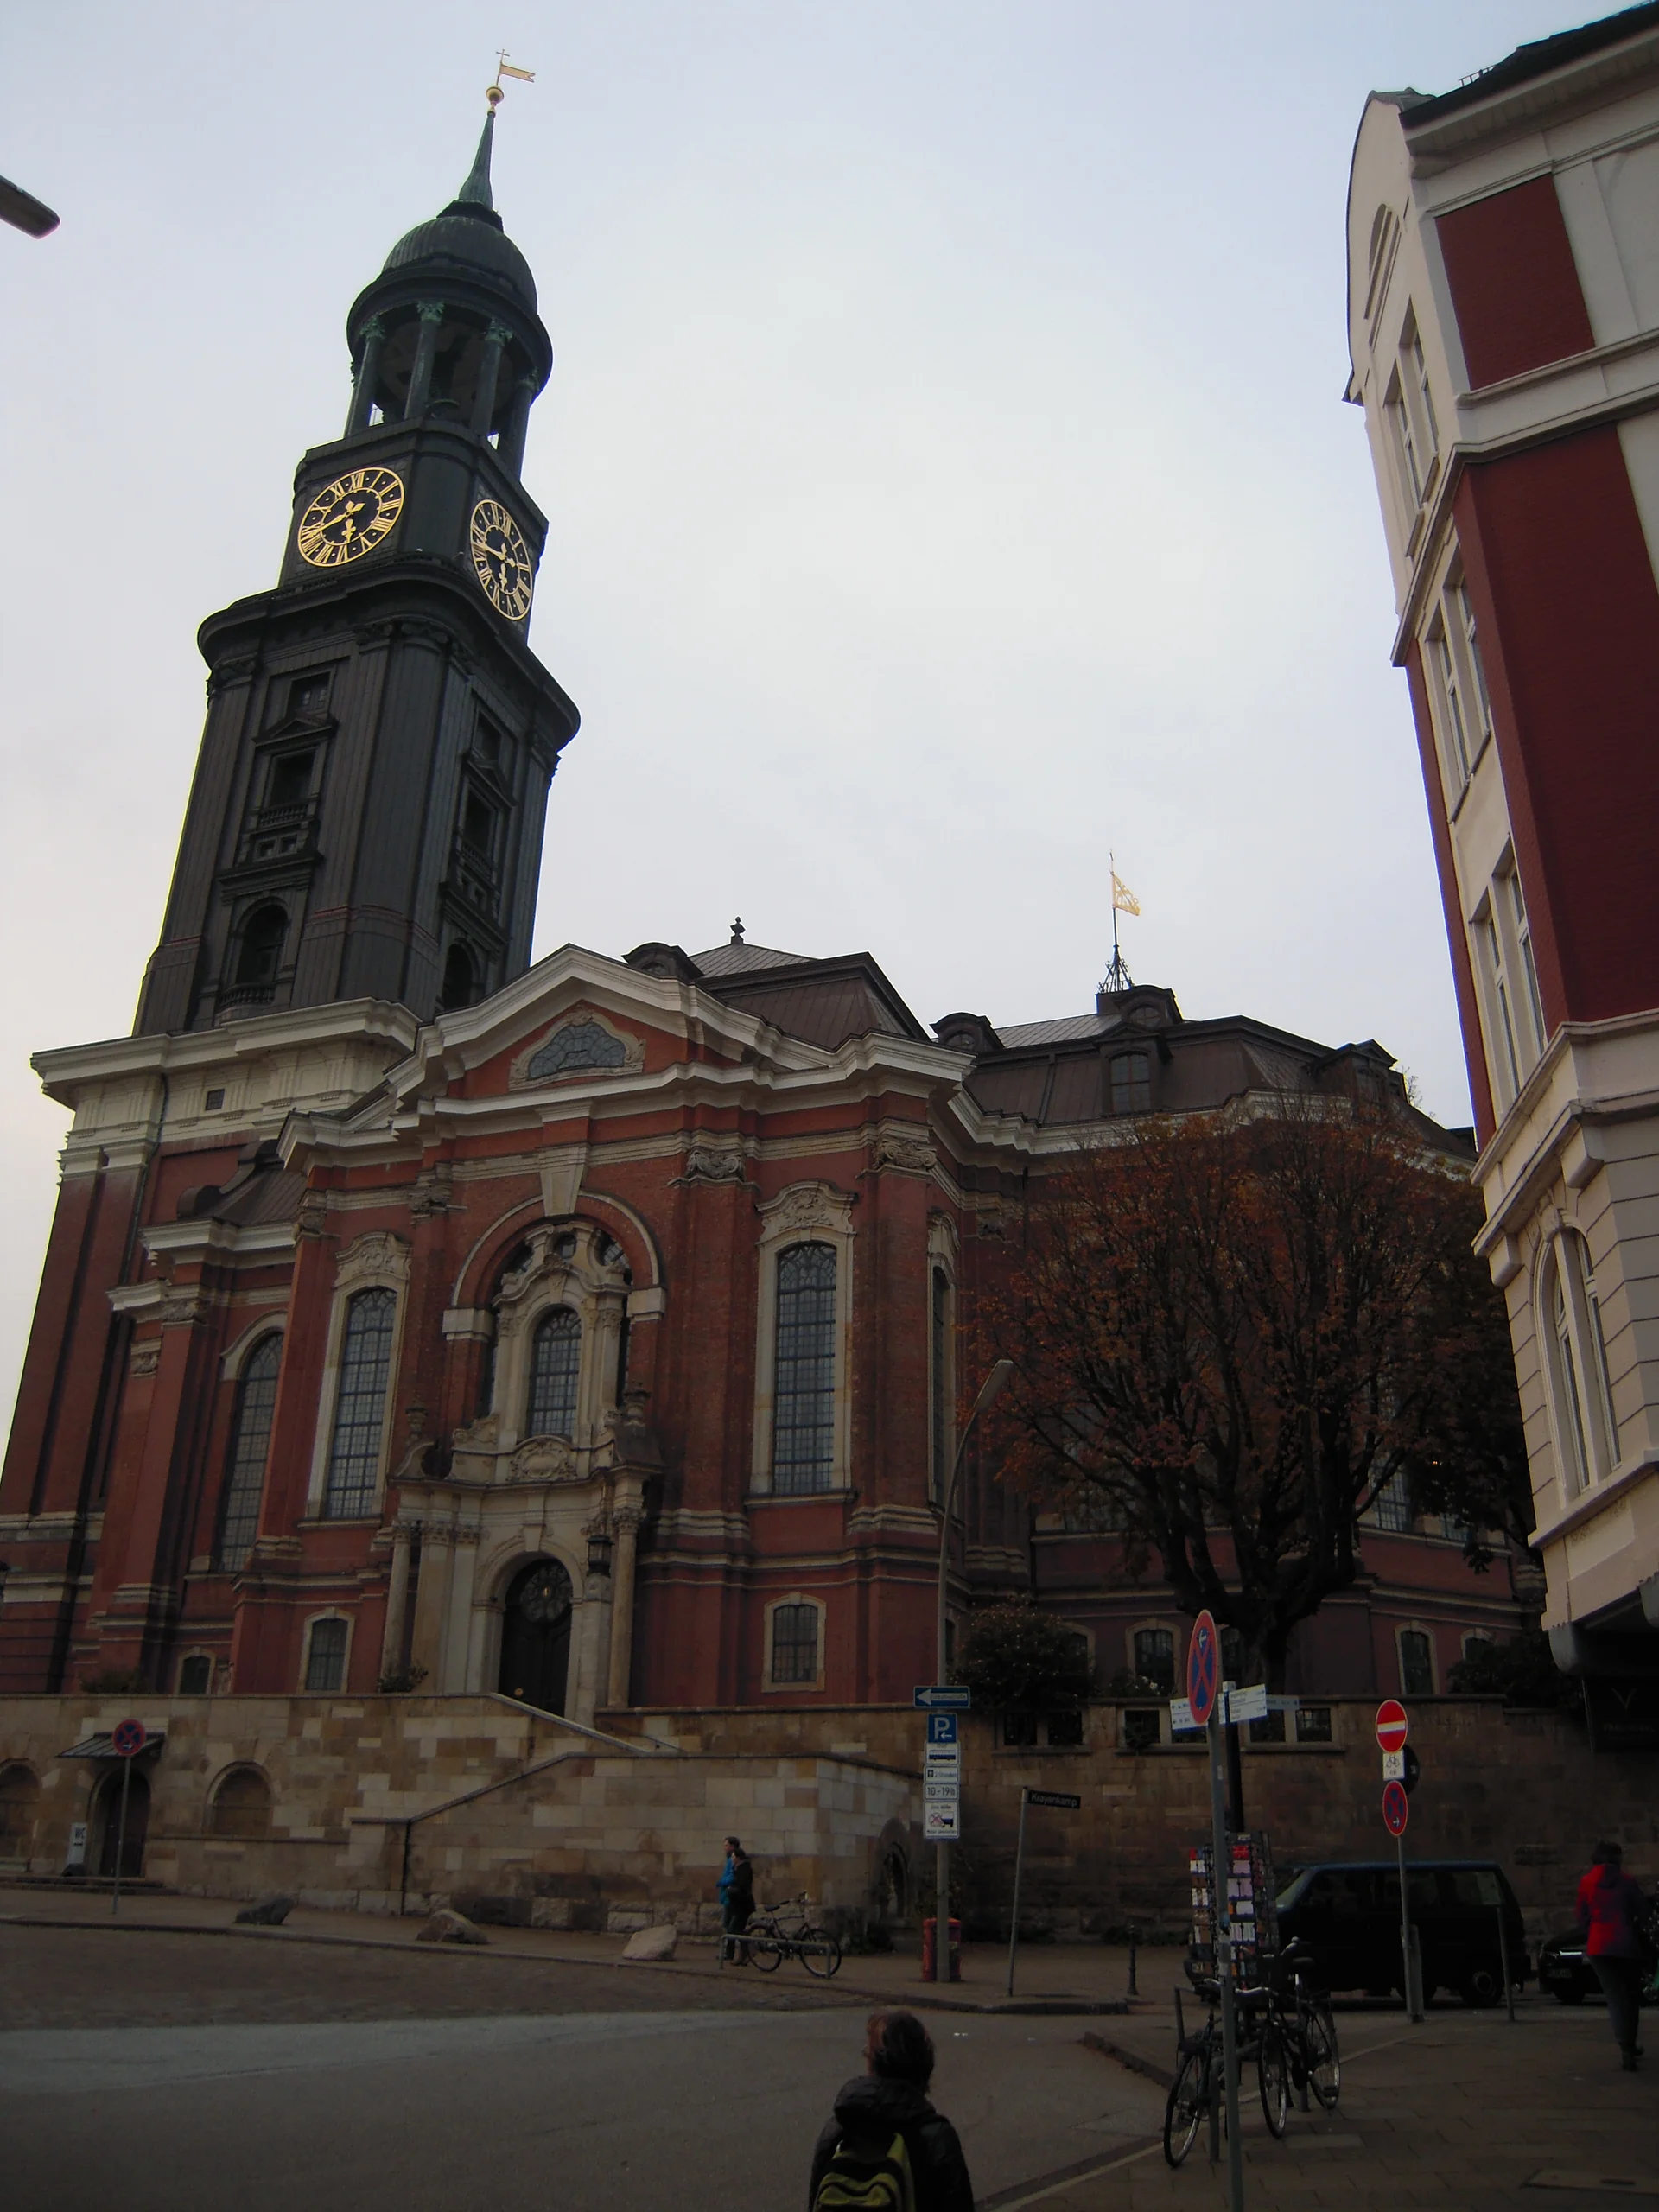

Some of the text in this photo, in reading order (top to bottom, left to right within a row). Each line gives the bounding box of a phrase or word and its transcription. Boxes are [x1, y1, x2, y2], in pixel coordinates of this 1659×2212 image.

[348, 471, 365, 491] XII
[369, 470, 385, 489] I
[329, 481, 346, 500] XI
[379, 480, 399, 498] II
[309, 502, 331, 513] X
[380, 498, 401, 512] III
[335, 543, 349, 563] VI
[360, 536, 373, 553] V
[934, 1717, 950, 1740] P
[1031, 1792, 1077, 1808] Krayenkamp
